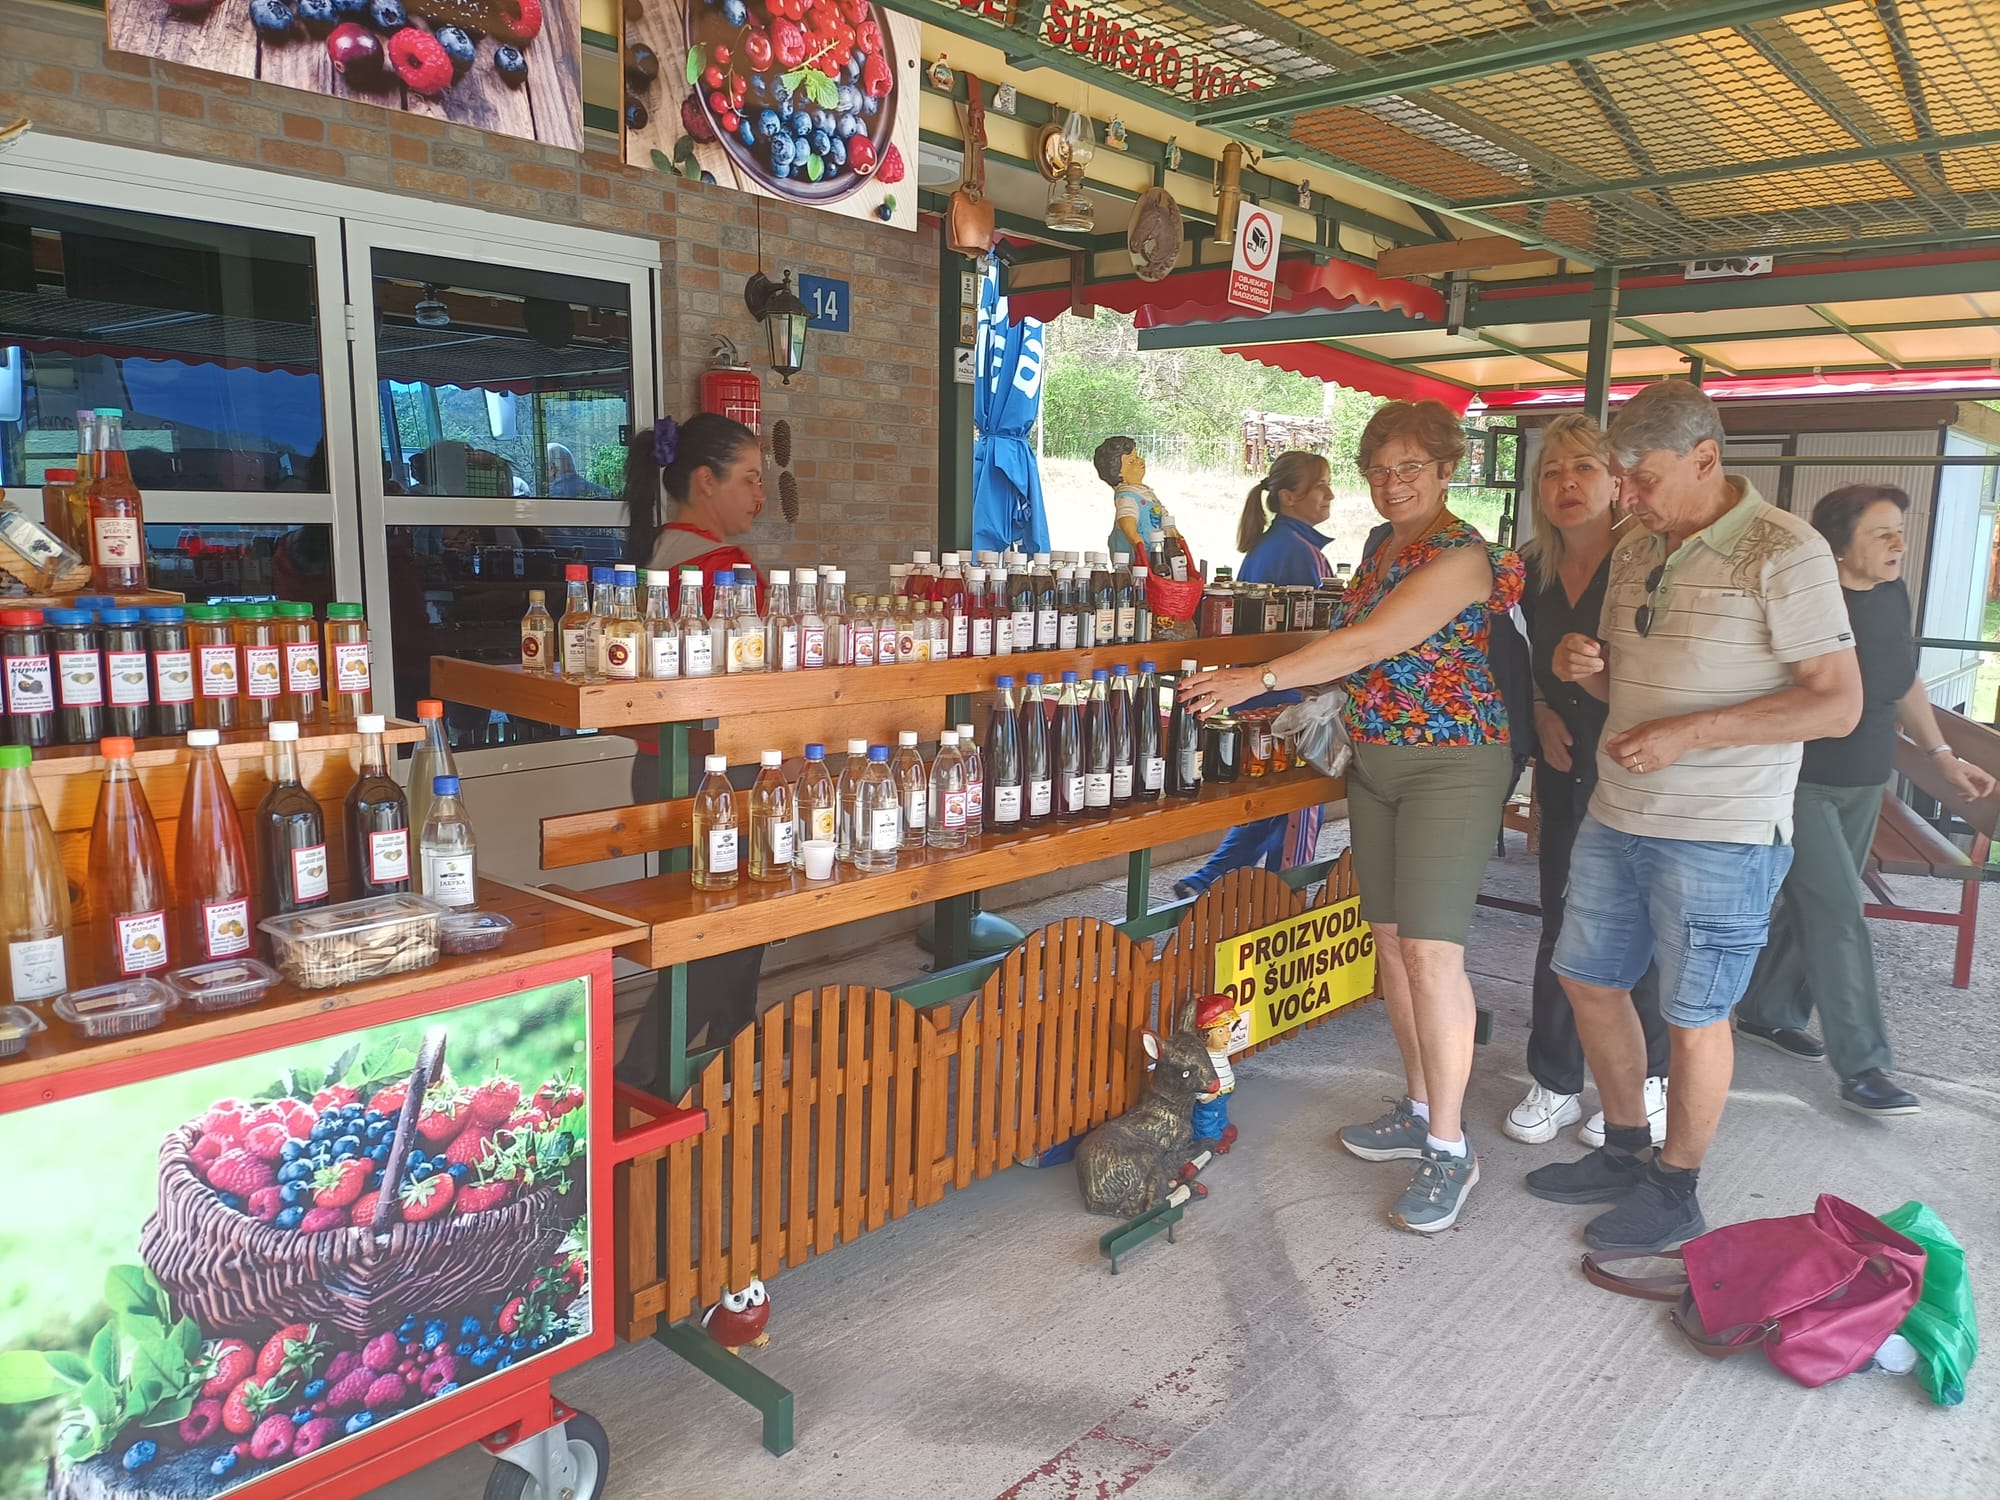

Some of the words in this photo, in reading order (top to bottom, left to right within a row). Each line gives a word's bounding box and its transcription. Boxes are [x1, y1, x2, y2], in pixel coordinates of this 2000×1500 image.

[1234, 282, 1249, 291] POD
[1250, 286, 1269, 297] VIDEO
[1238, 275, 1267, 289] OBJEKAT
[813, 287, 838, 321] 14
[1232, 290, 1269, 305] NADZOROM
[10, 666, 48, 674] KUPINA
[211, 903, 245, 914] LIKER
[125, 917, 161, 928] LIKER
[1239, 904, 1362, 971] PROIZVODI
[1264, 931, 1373, 996] ŠUMSKOG
[1268, 981, 1331, 1027] VOĆA
